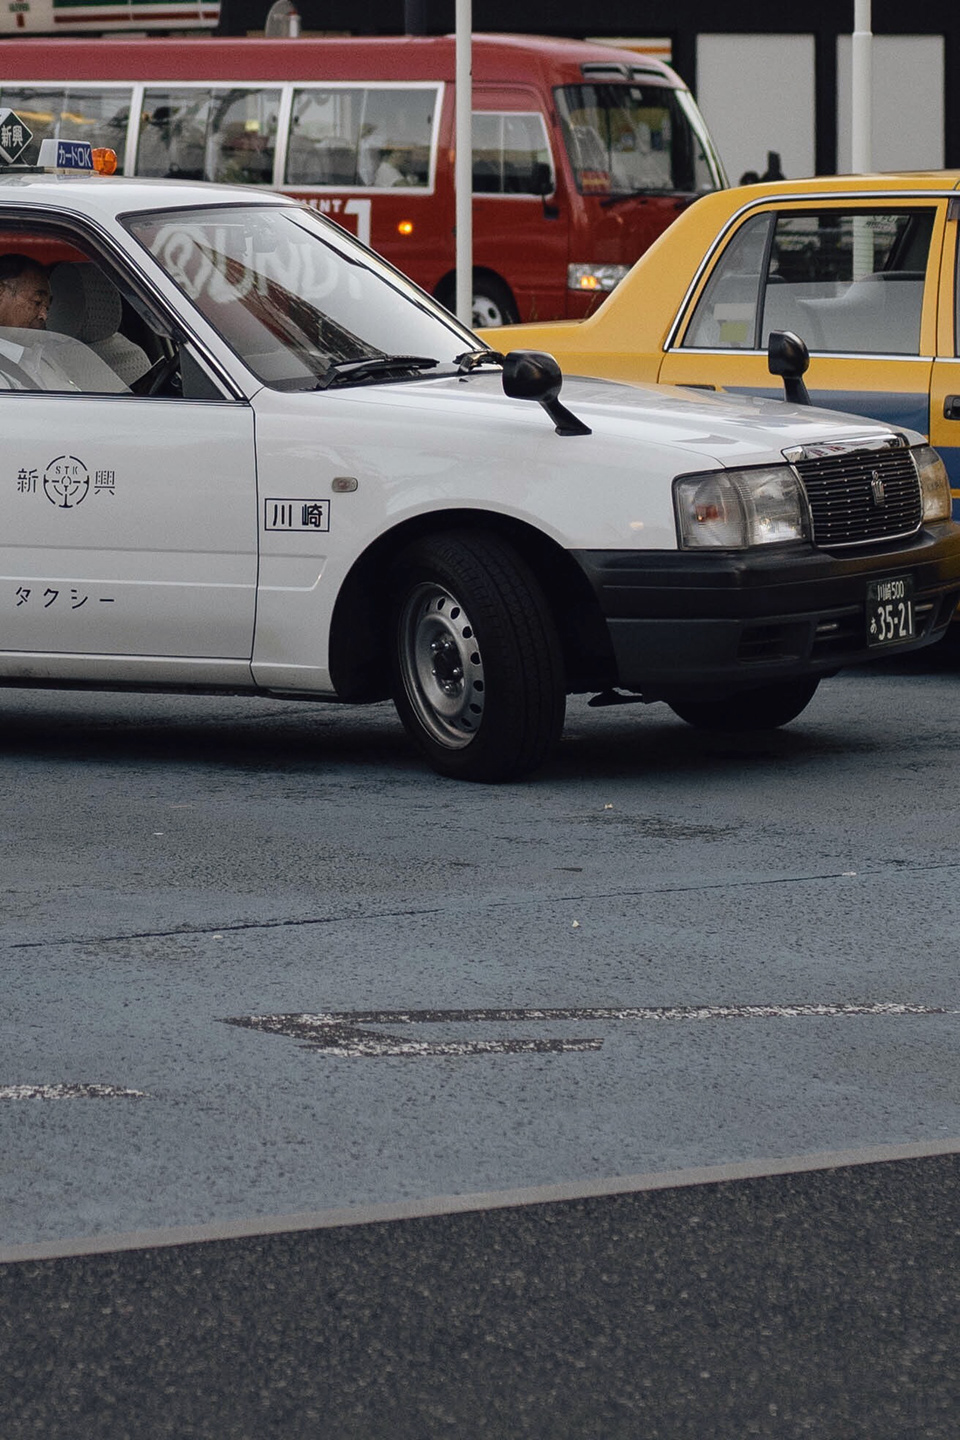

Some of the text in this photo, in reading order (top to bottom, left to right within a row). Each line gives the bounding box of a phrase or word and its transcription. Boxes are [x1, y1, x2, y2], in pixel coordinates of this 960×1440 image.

[1, 125, 23, 147] 新興
[58, 145, 92, 168] カードOK
[55, 465, 78, 475] STK
[272, 503, 323, 528] 川崎
[15, 587, 115, 609] タクシー
